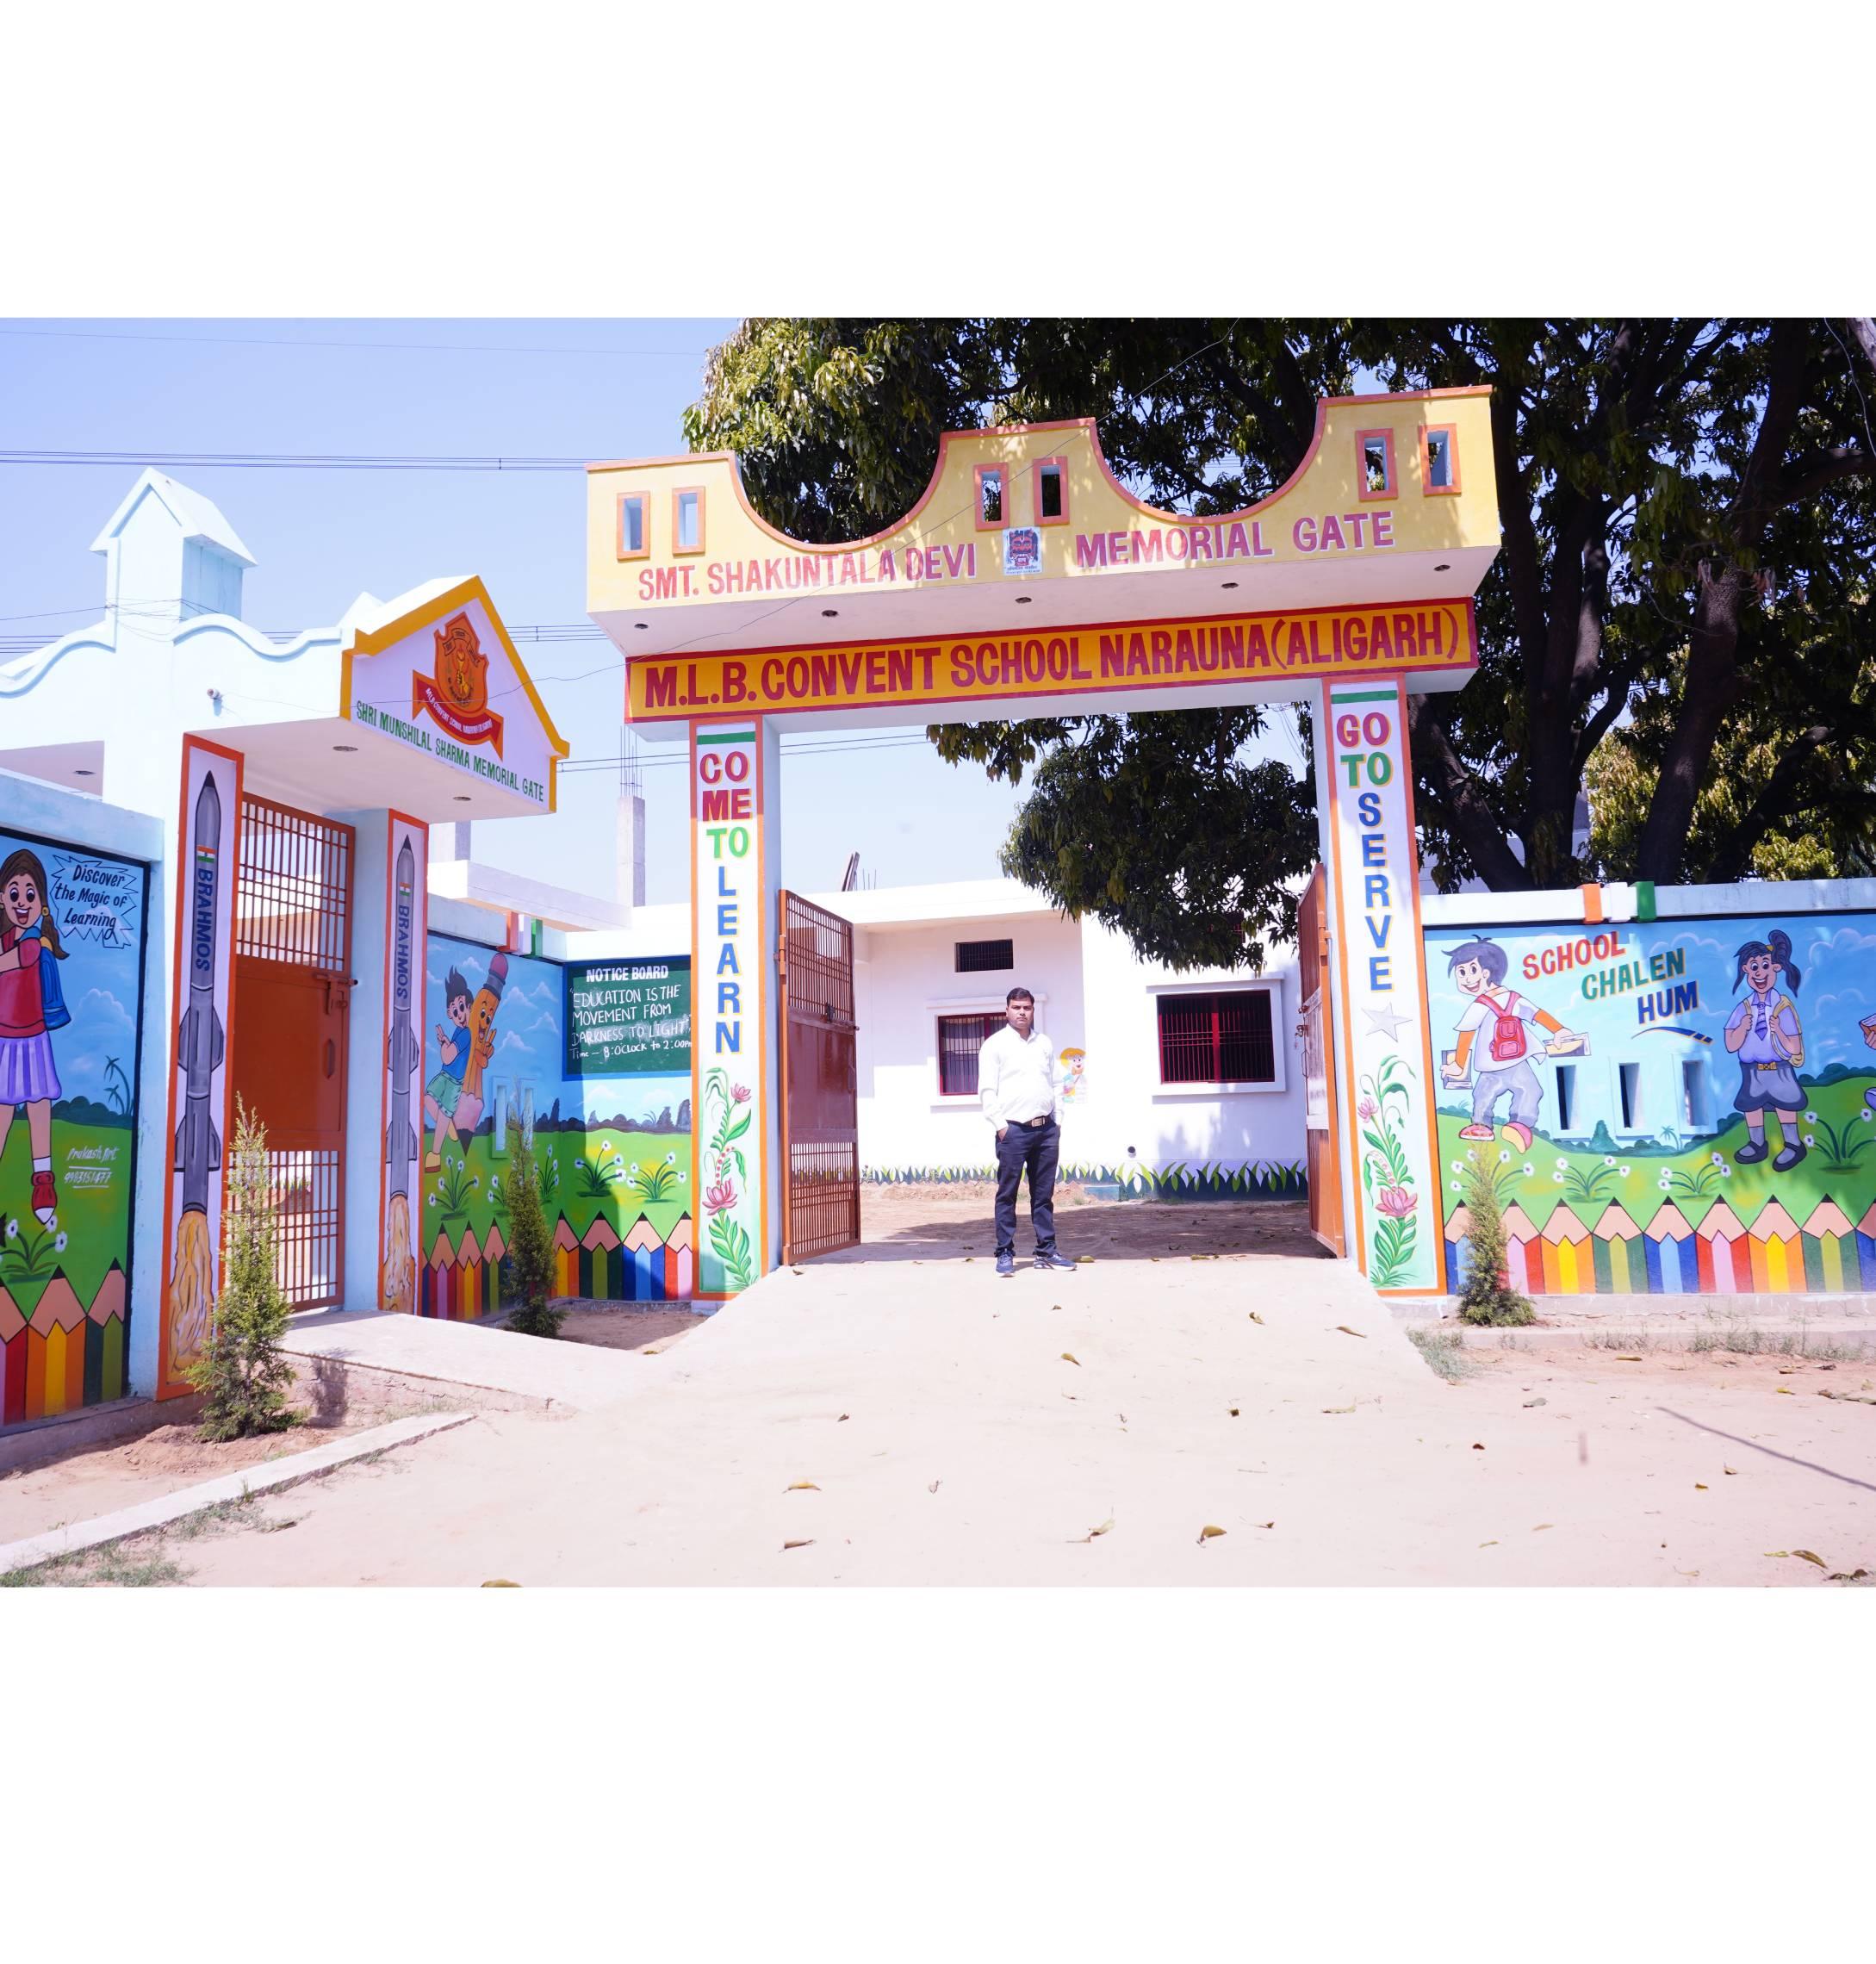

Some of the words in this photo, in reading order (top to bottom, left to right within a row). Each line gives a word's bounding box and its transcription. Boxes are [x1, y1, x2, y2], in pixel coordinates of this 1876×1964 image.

[638, 564, 699, 601] SMT.
[708, 549, 898, 594] SHAKUNTALA
[905, 543, 978, 582] DEVI
[1075, 520, 1275, 569] MEMORIAL
[1292, 510, 1395, 554] GATE
[644, 662, 757, 708] M.L.B.
[761, 646, 941, 699] CONVENT
[950, 637, 1091, 688] SCHOOL
[1336, 712, 1391, 748] GO
[357, 700, 376, 727] SHRI
[380, 712, 432, 752] MUNSHILAL
[435, 737, 470, 769] SHARMA
[473, 755, 519, 791] MEMORIAL
[522, 778, 544, 802] GATE
[1340, 751, 1393, 789] TO
[706, 826, 750, 859] TO
[54, 882, 75, 900] the
[78, 887, 109, 909] Magic
[113, 896, 127, 907] of
[72, 864, 125, 887] Discover
[1357, 792, 1395, 993] SERVE
[64, 907, 119, 945] Learning
[196, 867, 214, 972] BRAHMOS
[396, 905, 410, 999] BRAHMOS
[715, 866, 742, 1055] LEARN
[1522, 930, 1626, 980] SCHOOL
[586, 966, 629, 982] NOTICE
[631, 965, 669, 979] BOARD
[646, 987, 658, 1001] IS
[660, 984, 681, 999] THE
[1581, 948, 1686, 1000] CHALEN
[572, 1006, 637, 1027] MOVEMENT
[643, 1003, 672, 1019] FROM
[1637, 980, 1699, 1025] HUM
[571, 1029, 624, 1047] DARKNESS
[630, 1026, 644, 1037] TO
